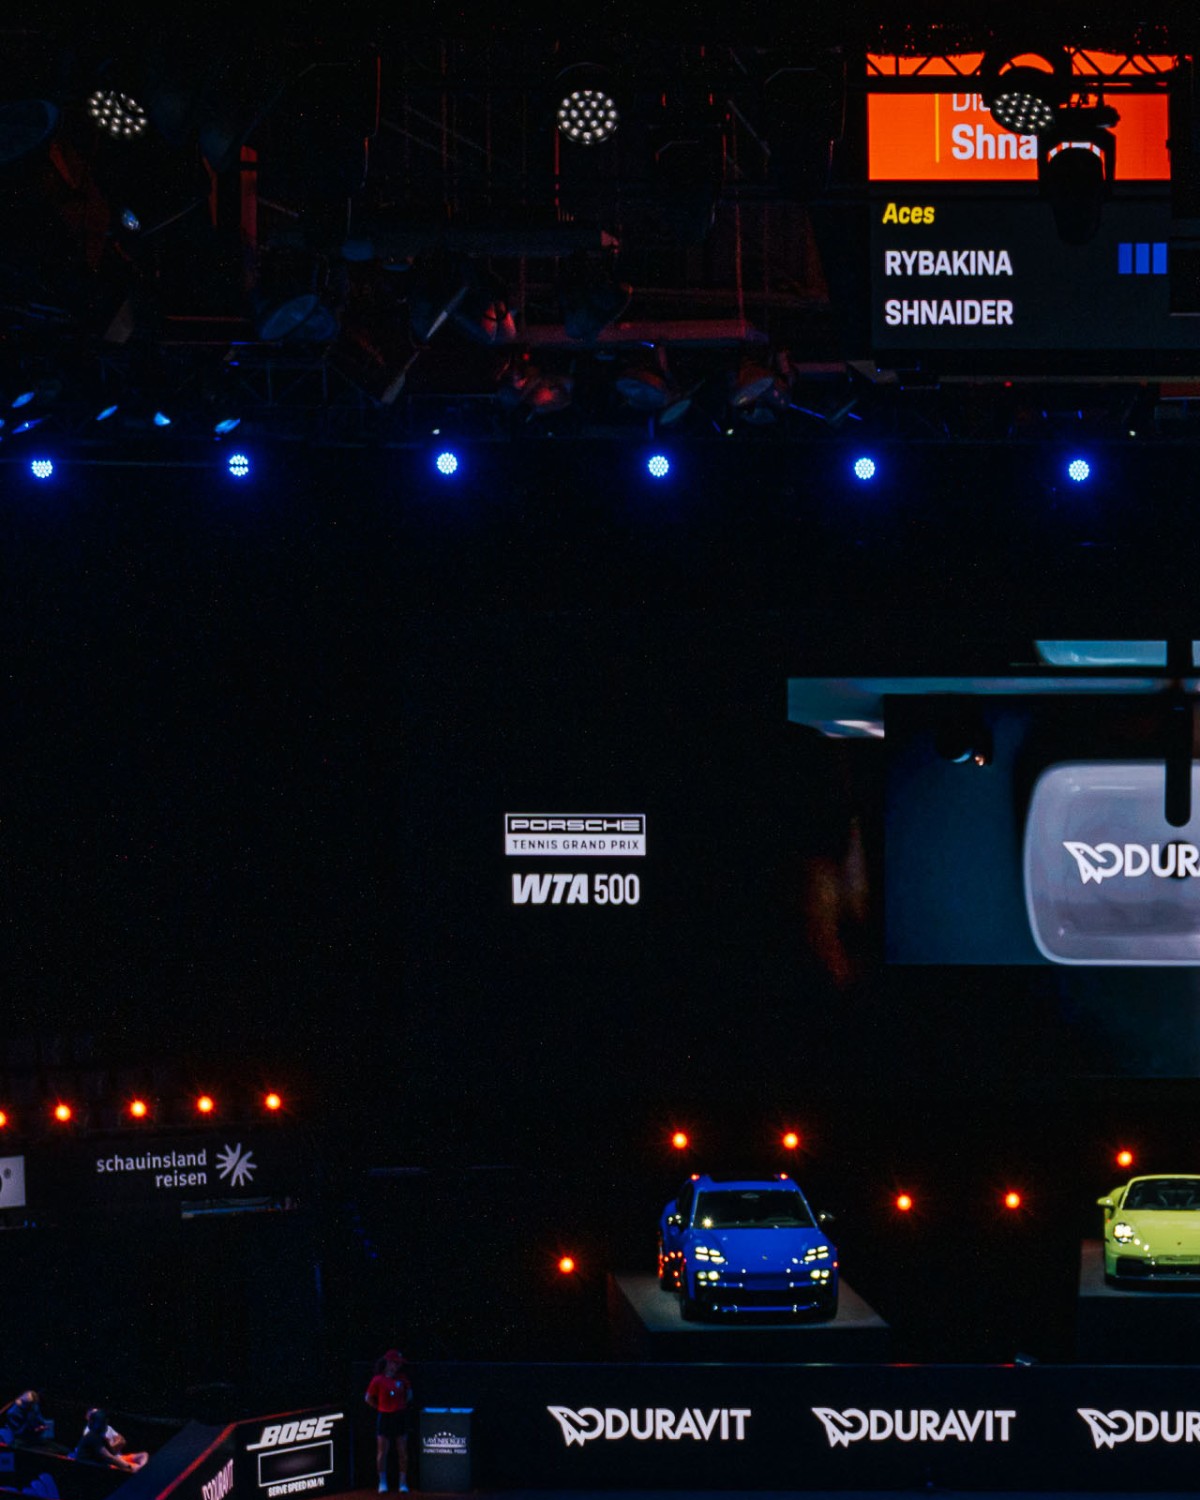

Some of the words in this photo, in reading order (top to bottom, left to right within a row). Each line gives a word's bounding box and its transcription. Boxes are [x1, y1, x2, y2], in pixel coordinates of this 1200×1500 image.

[882, 202, 935, 224] Aces
[885, 250, 1013, 276] RYBAKINA
[885, 299, 1014, 325] SHNAIDER
[510, 819, 640, 832] PORSCHE
[512, 839, 558, 850] TENNIS
[562, 839, 606, 850] GRAND
[610, 839, 640, 850] PRIX
[512, 873, 589, 905] WTA
[594, 873, 640, 905] 500
[96, 1148, 207, 1174] schauinsland
[155, 1170, 207, 1188] reisen
[246, 1412, 344, 1451] BOSE
[605, 1407, 752, 1441] DURAVIT
[869, 1409, 1016, 1442] DURAVIT
